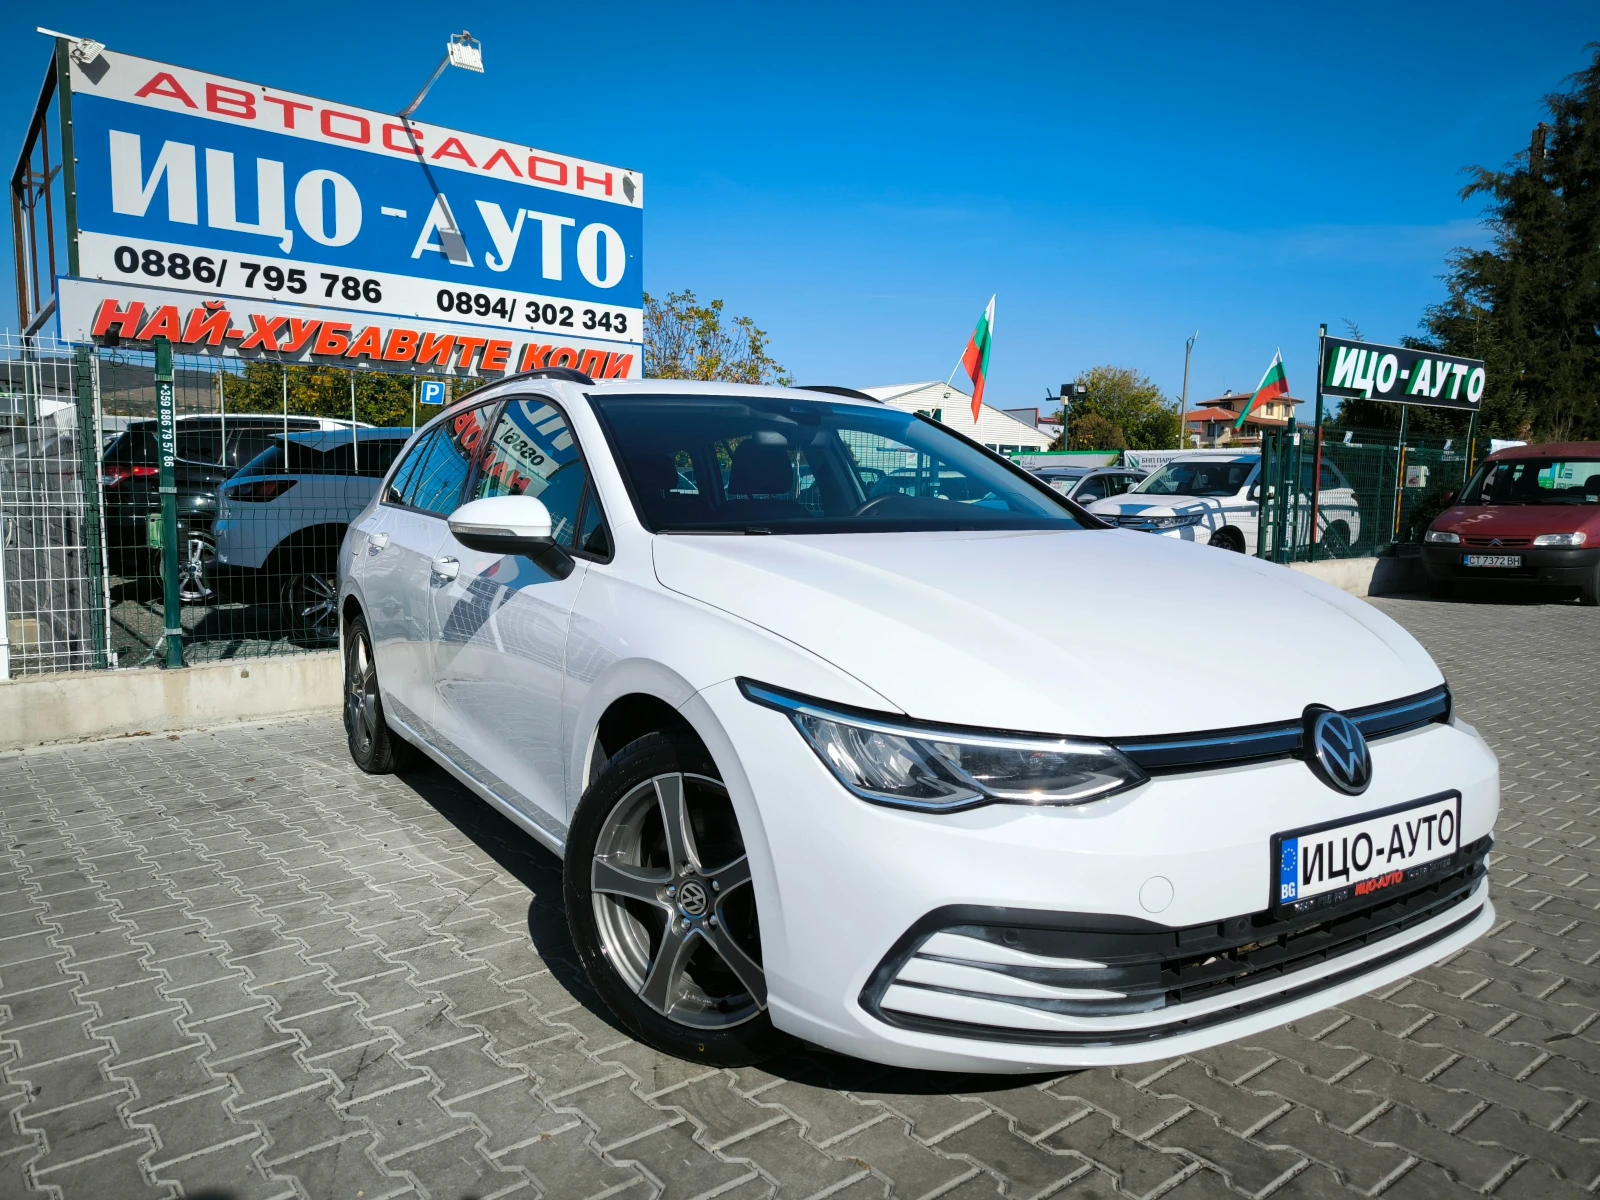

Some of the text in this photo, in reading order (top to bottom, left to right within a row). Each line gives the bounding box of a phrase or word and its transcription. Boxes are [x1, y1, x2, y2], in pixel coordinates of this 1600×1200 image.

[134, 71, 612, 196] АВТОСАЛОН
[114, 246, 382, 303] 0886/ 795 786
[92, 298, 634, 380] НАЙ-ХУБАВИТЕ КОЛИ
[437, 289, 627, 334] 0894/ 302 343
[426, 384, 440, 401] P
[1331, 346, 1485, 403] ИЦО-АУТО
[160, 384, 174, 467] +359 886 79 57 86
[1482, 557, 1506, 565] 7372
[1302, 809, 1454, 886] ИЦО-АУТО
[1281, 882, 1296, 899] BG
[1355, 869, 1404, 896] ИЦО-АУТО
